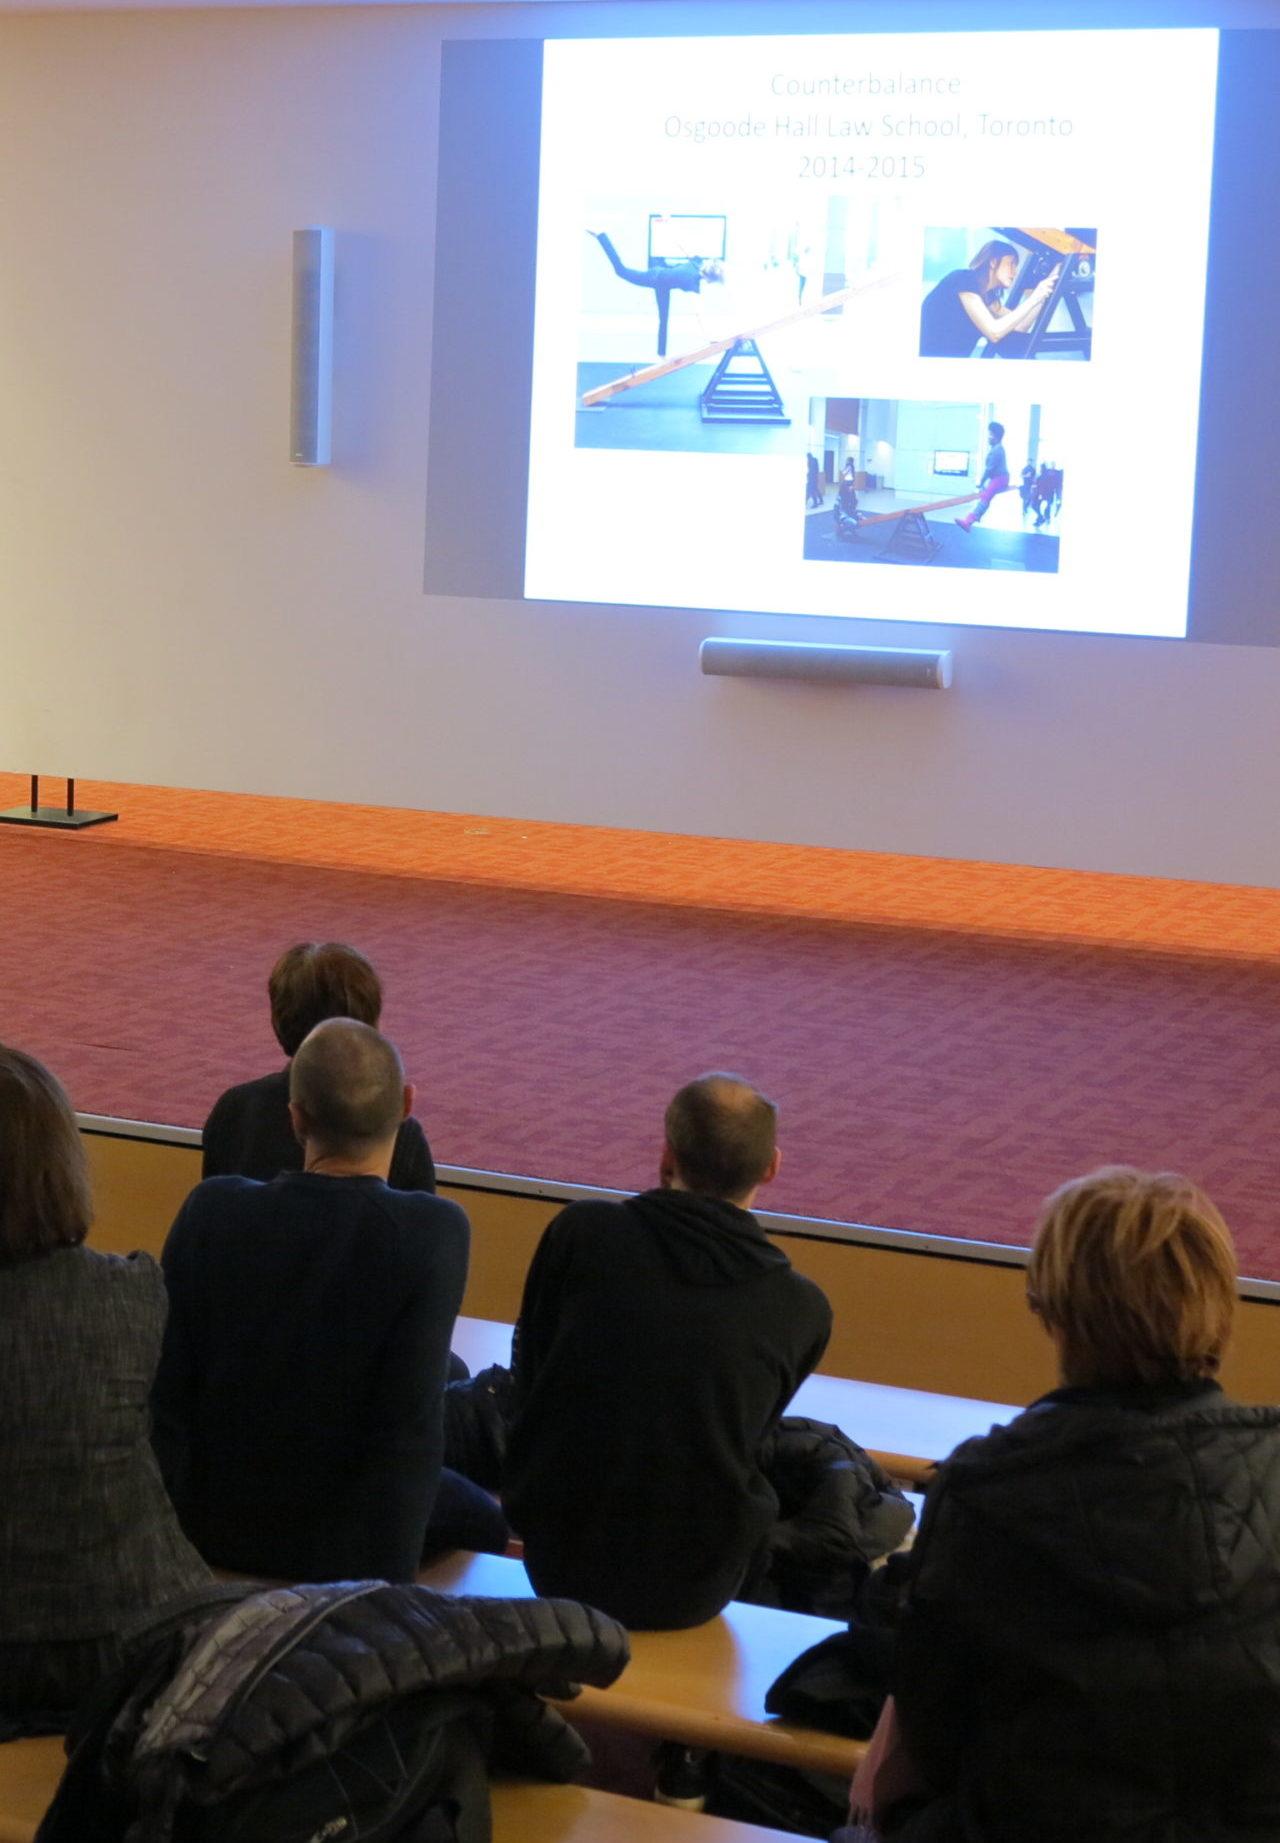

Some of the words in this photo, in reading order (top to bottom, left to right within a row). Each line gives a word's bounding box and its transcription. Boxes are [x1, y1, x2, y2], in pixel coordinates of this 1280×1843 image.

[770, 72, 961, 96] Counterbalance
[664, 114, 766, 143] Osgoode
[775, 115, 818, 137] Hall
[827, 115, 873, 137] Law
[881, 113, 968, 140] School,
[977, 113, 1074, 137] Toronto
[798, 155, 926, 179] 2014-2015
